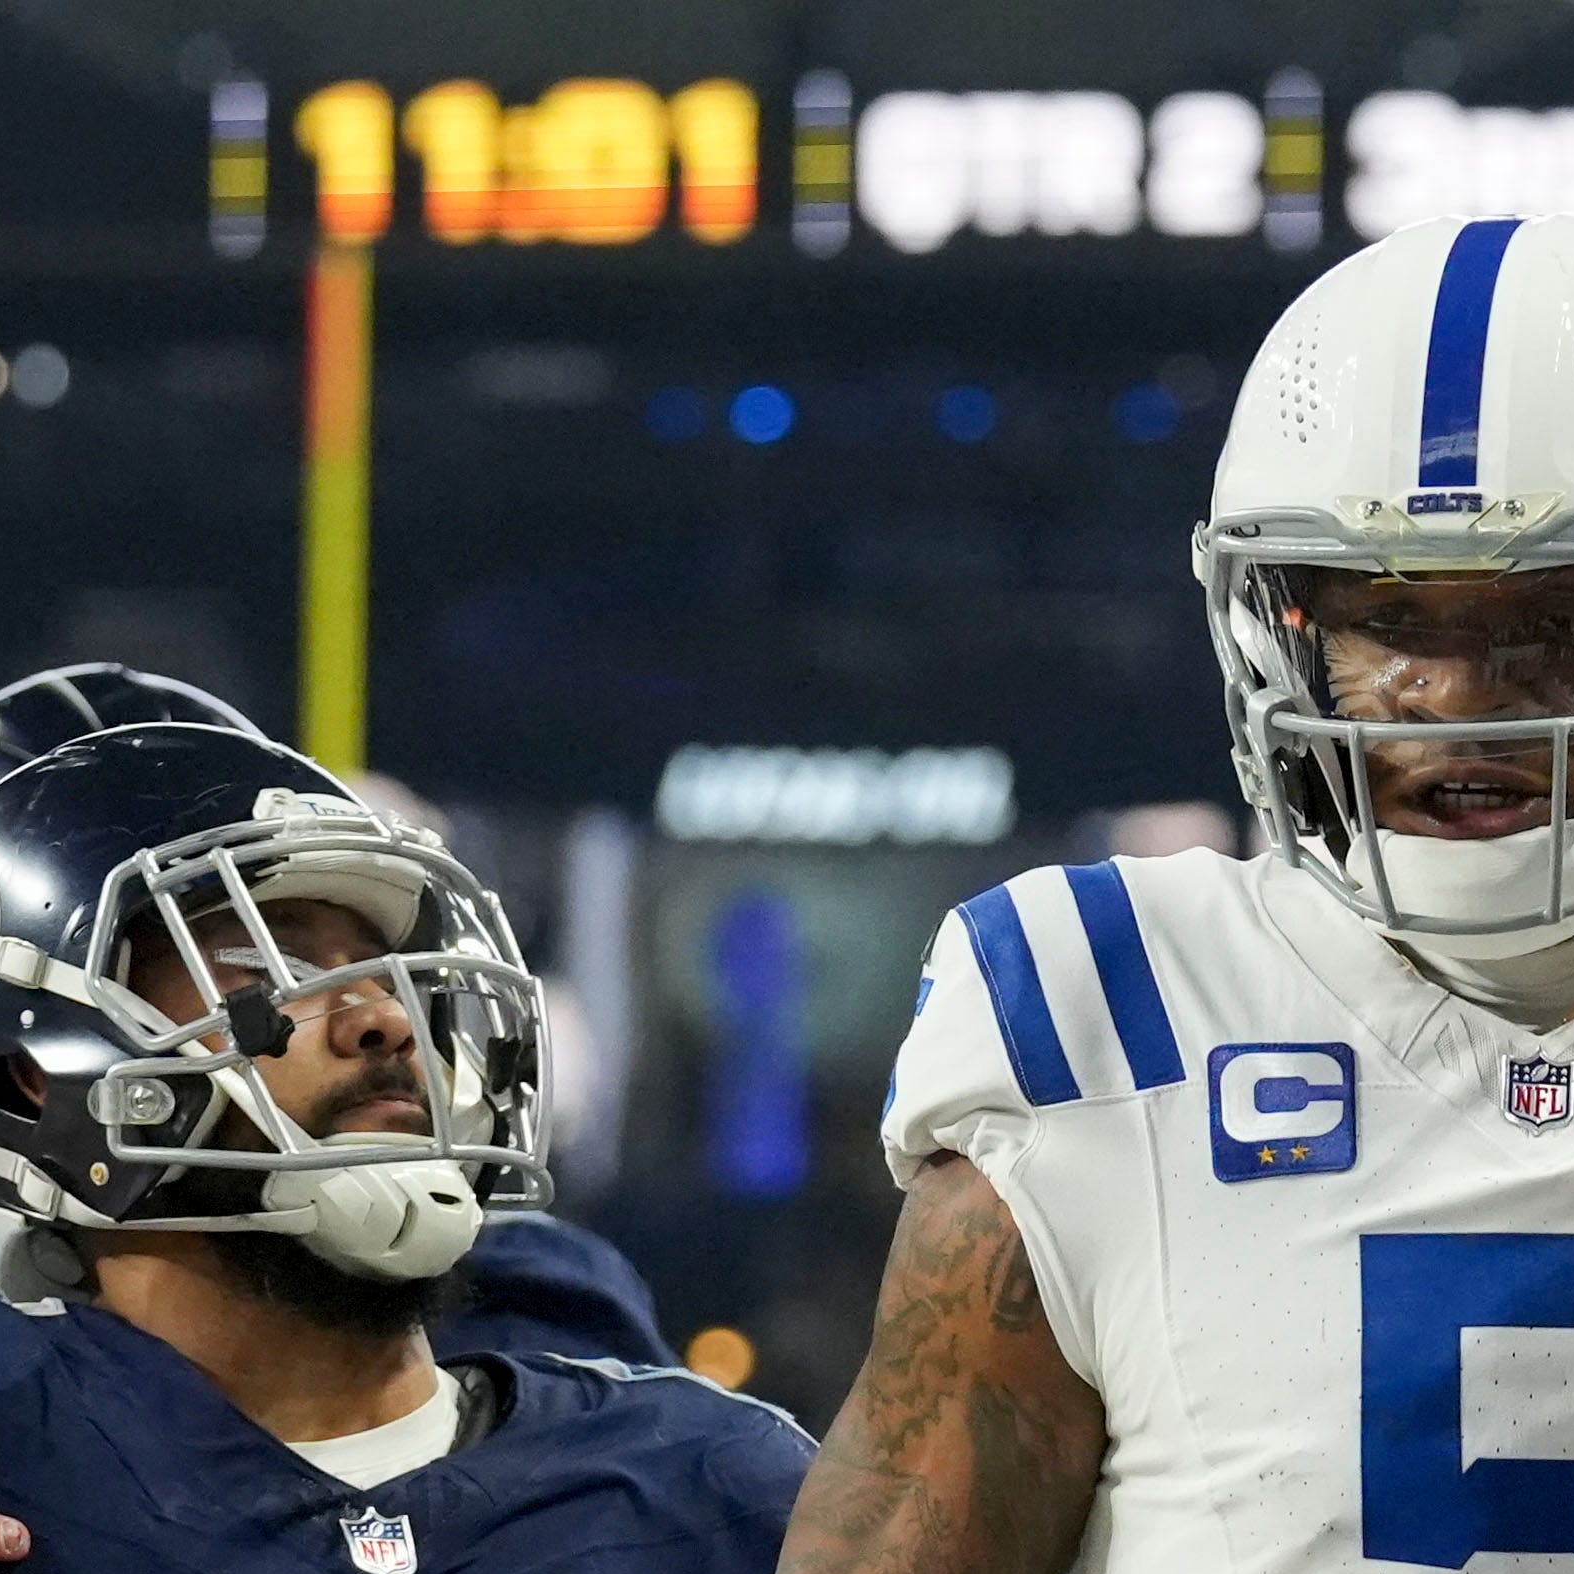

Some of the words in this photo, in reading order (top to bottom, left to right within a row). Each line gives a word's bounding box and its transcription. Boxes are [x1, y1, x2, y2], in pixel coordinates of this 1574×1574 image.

[1407, 492, 1483, 515] COLTS
[1219, 1051, 1347, 1143] C
[1514, 1085, 1565, 1119] NFL
[359, 1539, 407, 1566] NFL
